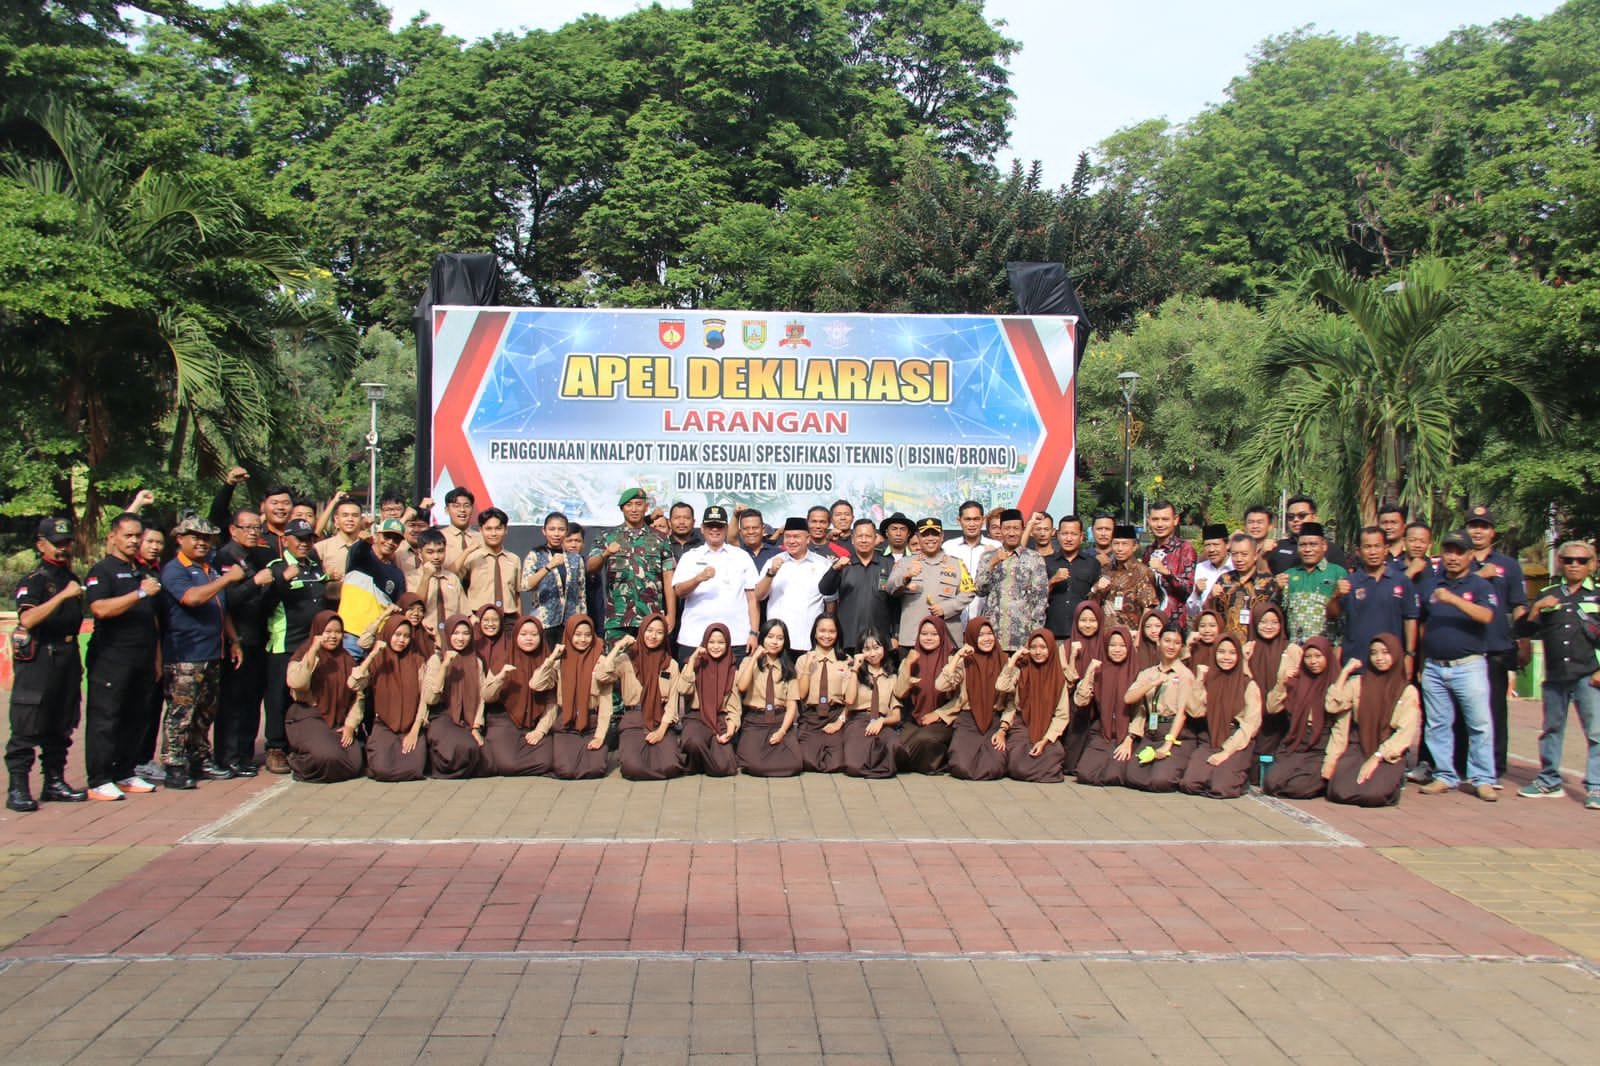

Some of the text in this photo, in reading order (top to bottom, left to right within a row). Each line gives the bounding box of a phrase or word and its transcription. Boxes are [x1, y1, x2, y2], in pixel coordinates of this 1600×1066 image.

[561, 354, 950, 402] APEL DEKLARASI
[663, 410, 848, 433] LARANGAN
[491, 441, 585, 460] PENGGUNAAN
[590, 442, 653, 461] KNALPOT
[657, 443, 698, 462] TIDAK
[702, 444, 751, 463] SESUAI
[756, 444, 840, 464] SPESIFIKASI
[845, 446, 894, 465] TEKNIS
[908, 447, 1006, 465] BISING/BRONG
[678, 472, 833, 491] DI KABUPATEN KUDUS
